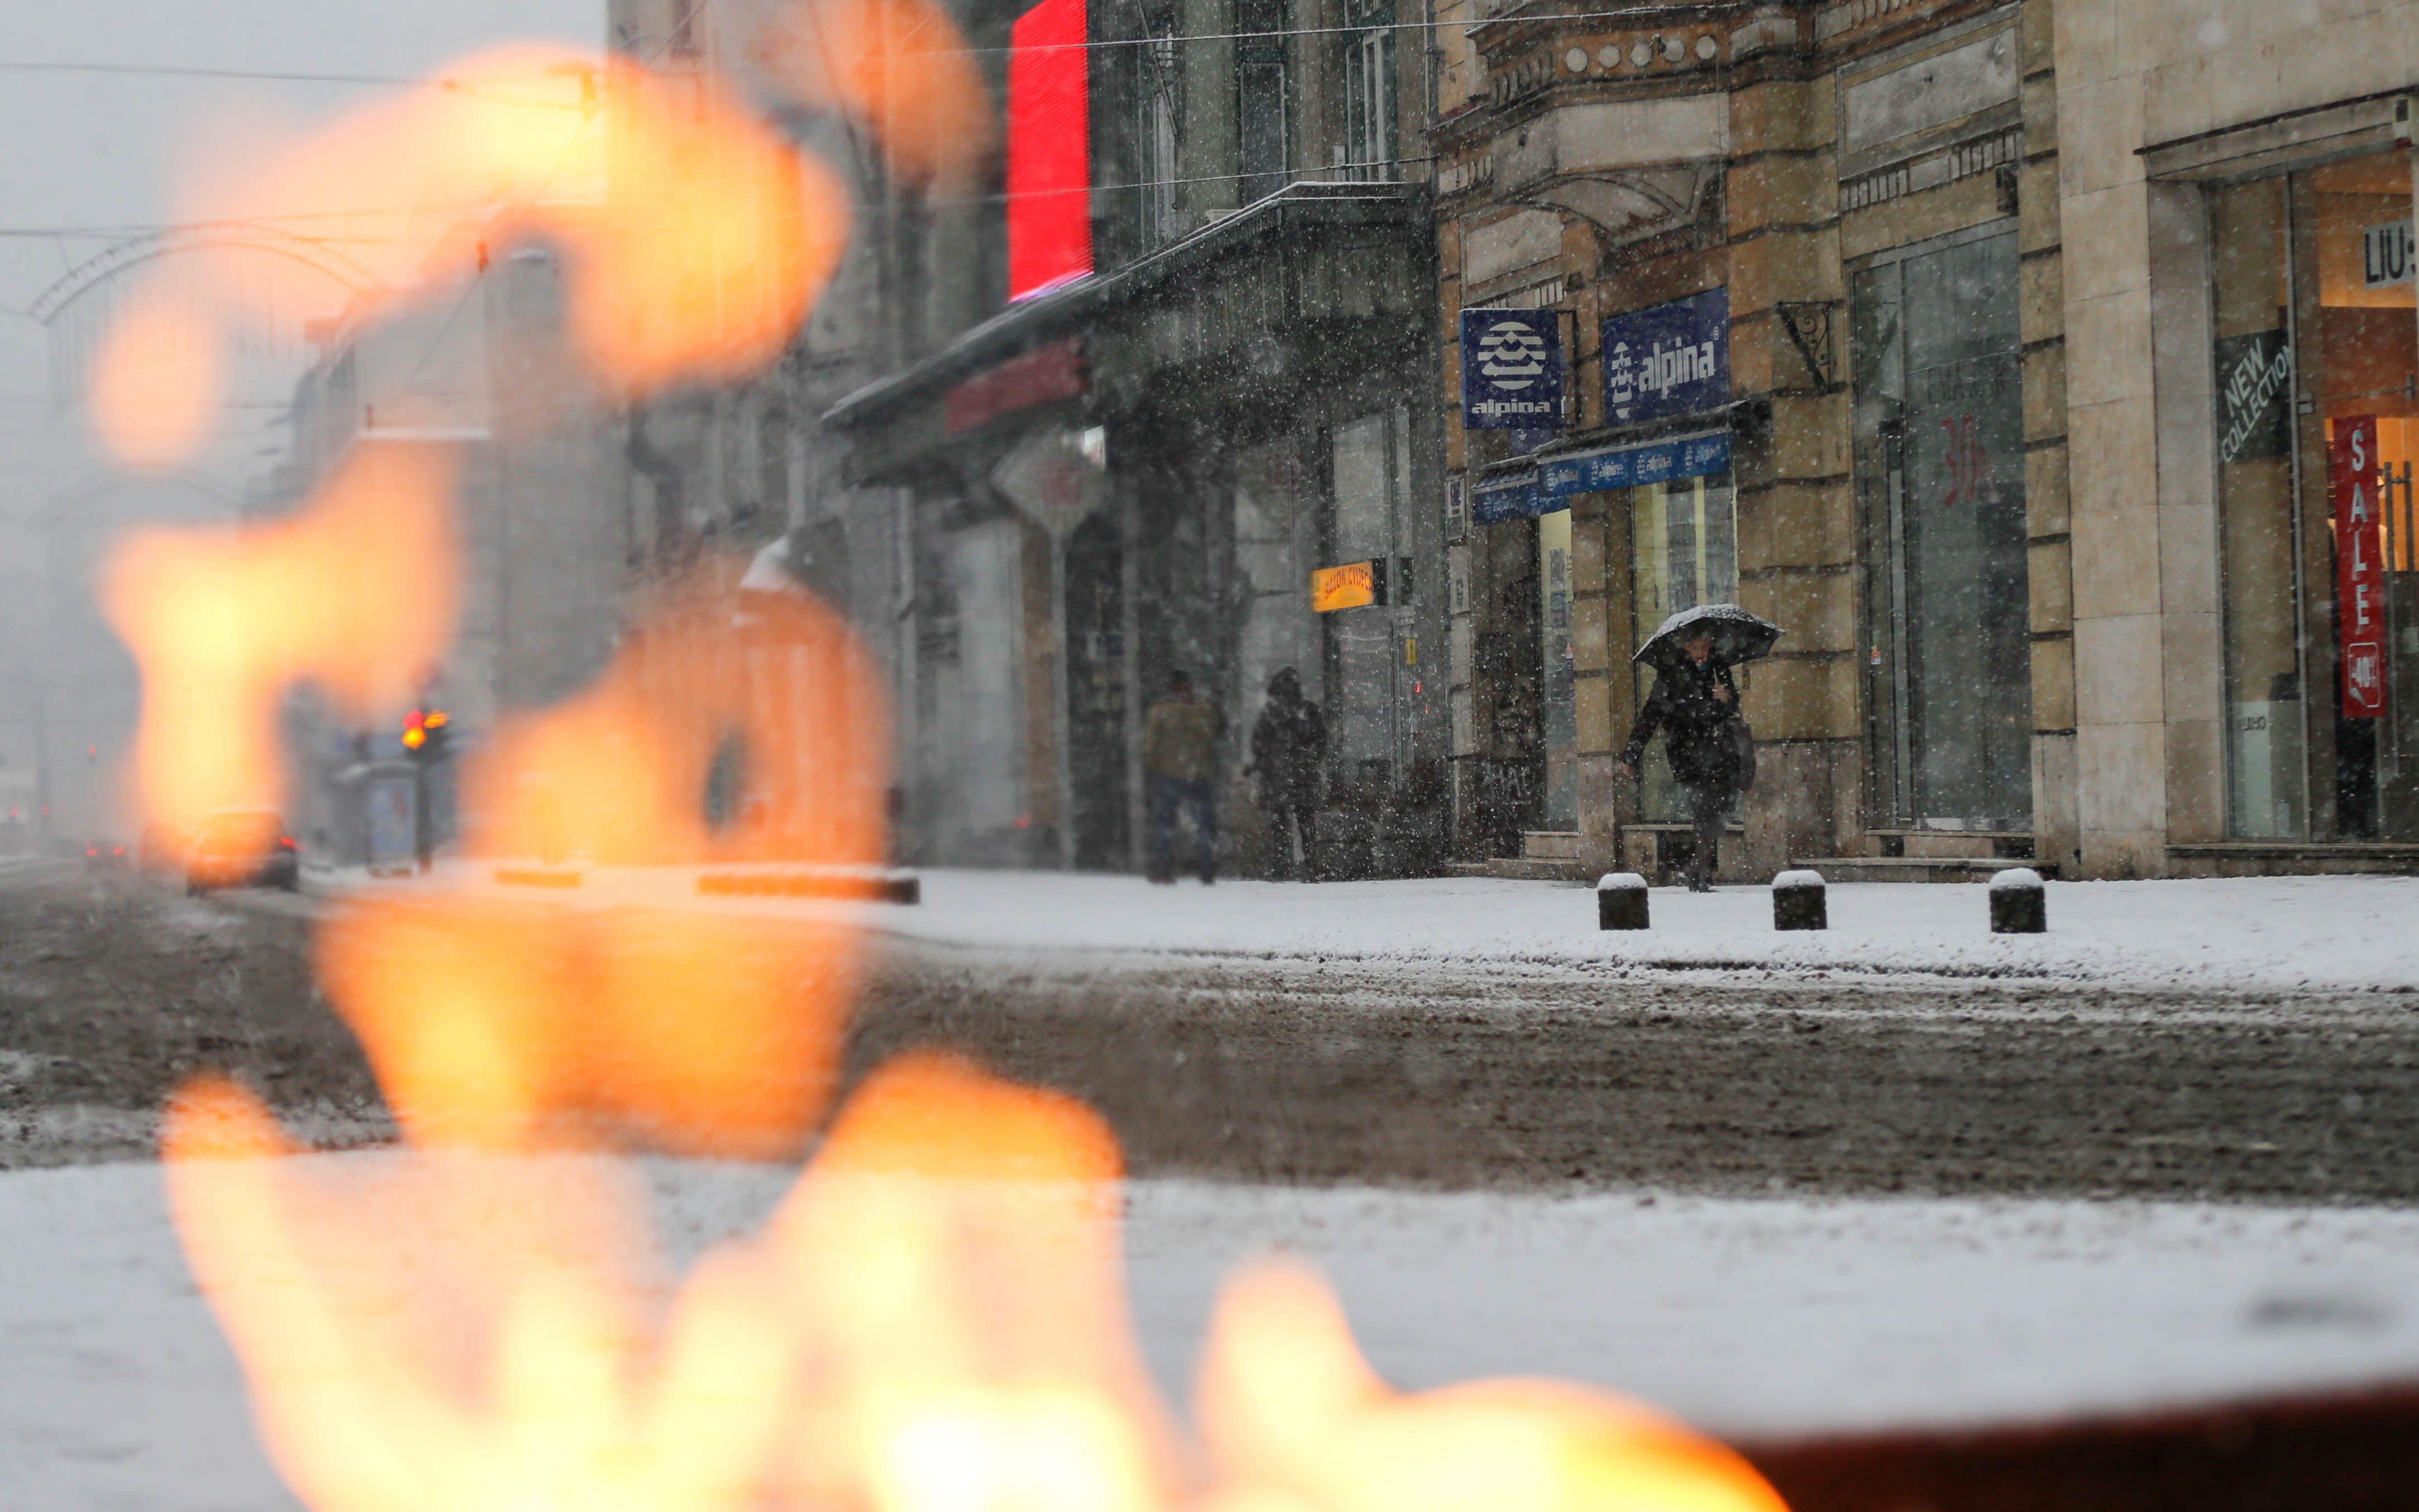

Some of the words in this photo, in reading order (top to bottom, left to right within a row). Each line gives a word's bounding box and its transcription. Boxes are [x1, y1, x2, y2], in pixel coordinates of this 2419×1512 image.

[1639, 337, 1715, 399] alpina
[2225, 337, 2265, 418] NEW
[1471, 398, 1550, 417] alpina
[2350, 429, 2370, 625] SALE
